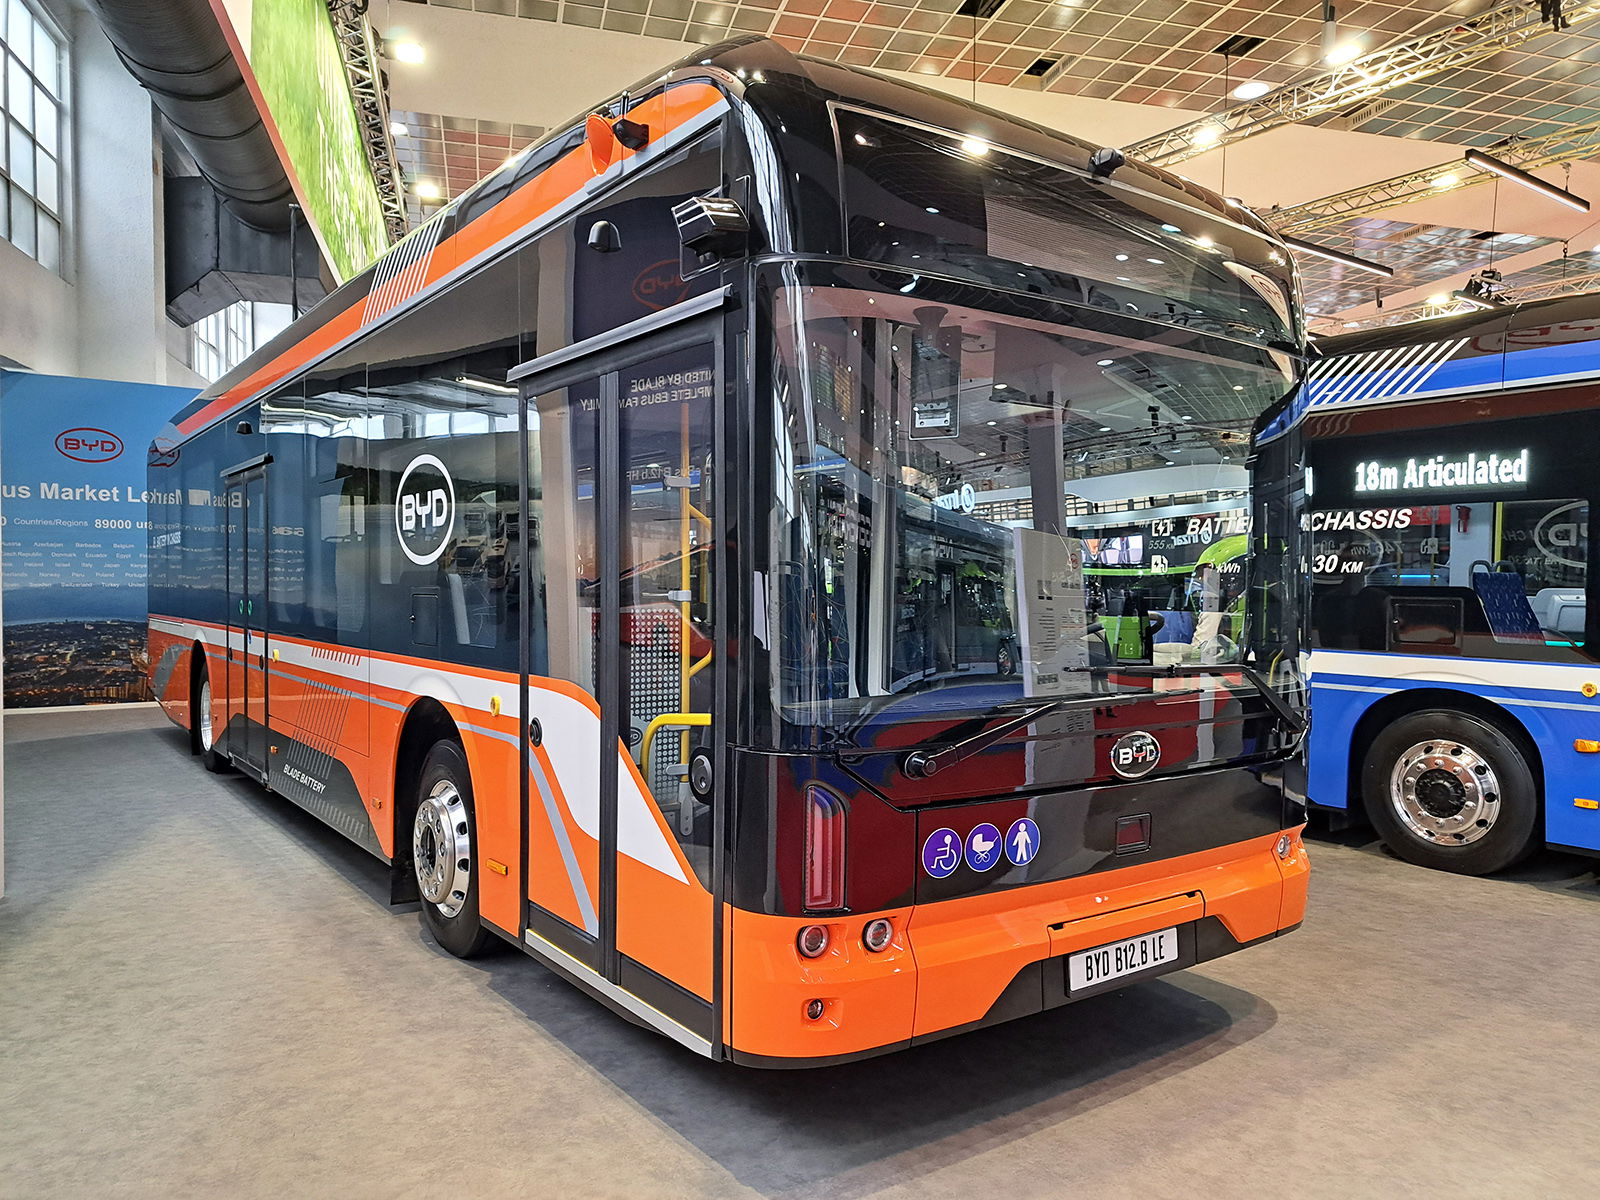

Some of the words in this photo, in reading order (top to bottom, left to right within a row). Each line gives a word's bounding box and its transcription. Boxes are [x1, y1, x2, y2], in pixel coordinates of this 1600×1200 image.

[63, 438, 117, 452] BYD
[1355, 461, 1398, 492] 18m
[1403, 448, 1528, 489] Articulated
[40, 482, 119, 502] Market
[402, 488, 448, 531] BYD
[1311, 508, 1413, 532] CHASSIS
[13, 518, 88, 527] Countries/Regions
[94, 519, 132, 529] 89000
[1340, 561, 1364, 574] KM
[1119, 745, 1156, 765] BYD
[282, 763, 302, 780] BLADE
[299, 773, 327, 795] BATTERY
[1085, 950, 1110, 982] BYD
[1115, 940, 1148, 972] B12.B
[1152, 934, 1165, 962] LE
